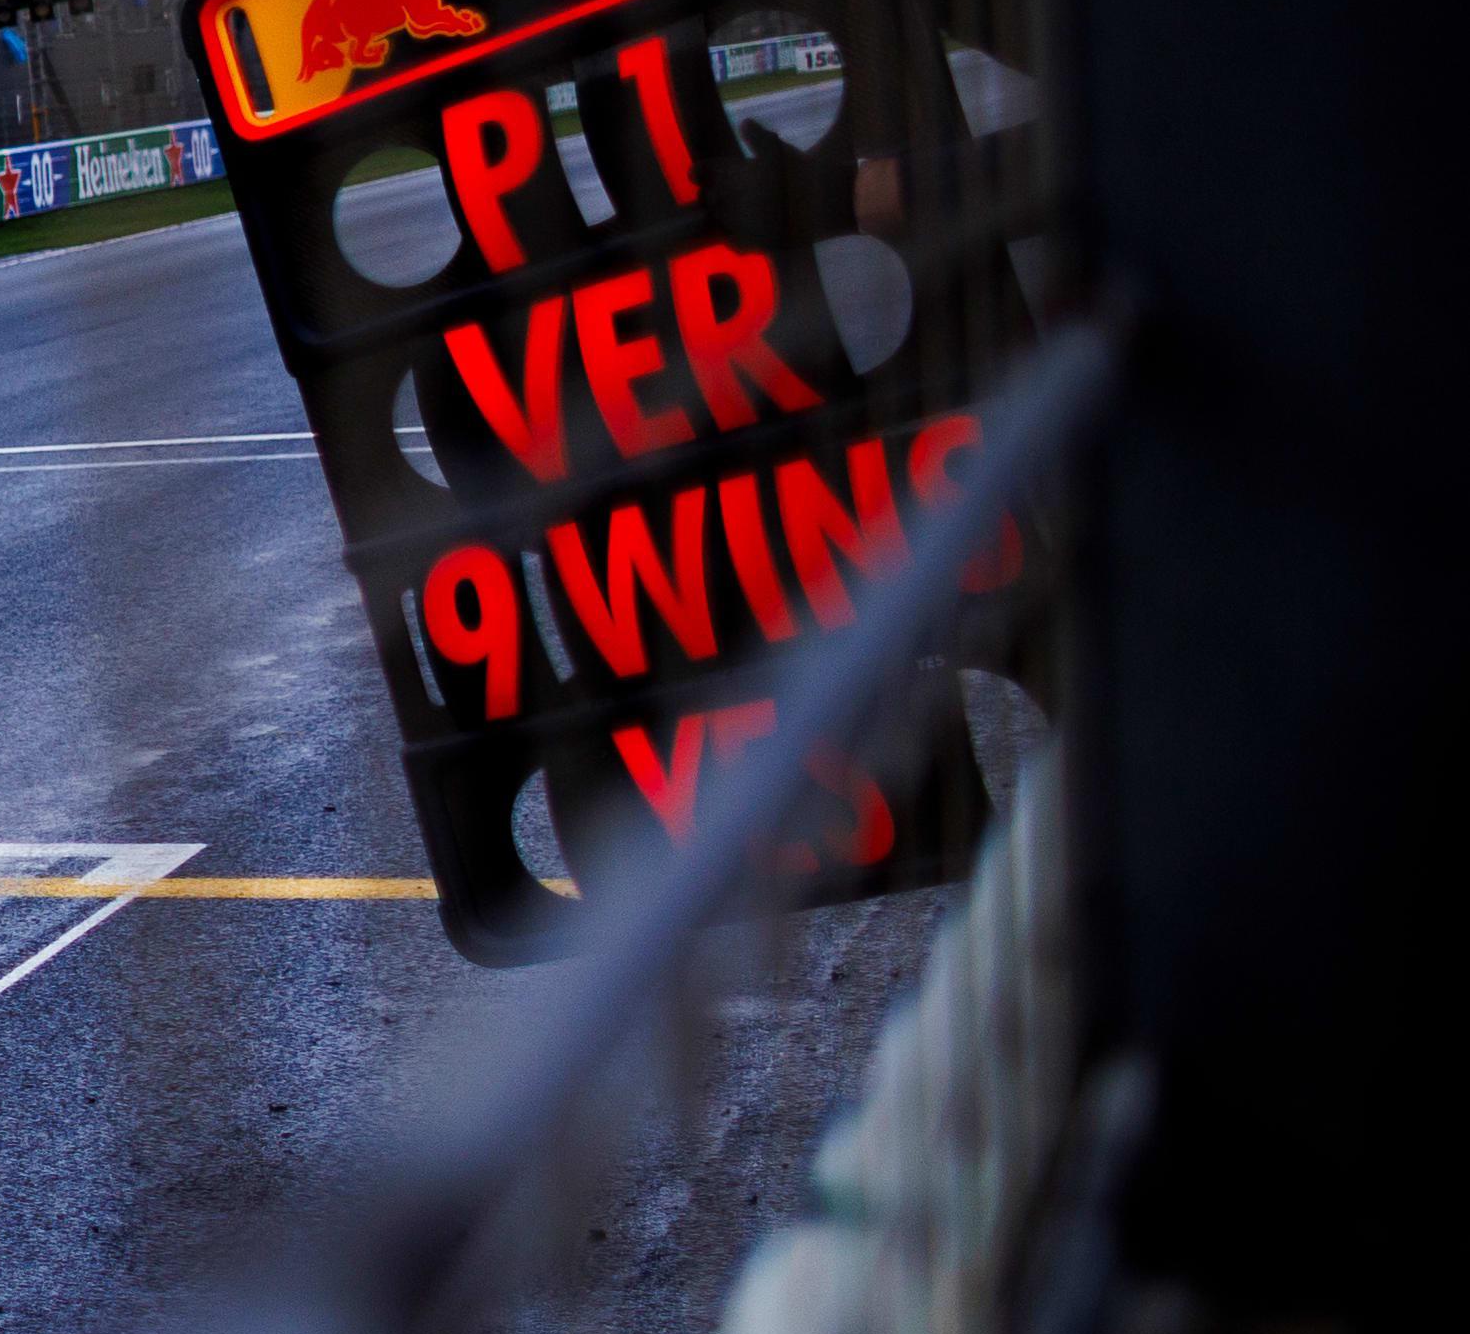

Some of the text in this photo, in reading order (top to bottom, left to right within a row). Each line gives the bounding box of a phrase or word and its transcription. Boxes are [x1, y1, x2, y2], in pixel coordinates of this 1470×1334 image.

[76, 139, 165, 200] Heineken
[440, 34, 701, 275] P 1
[443, 243, 828, 483] VER
[422, 414, 1024, 722] 9 WINS
